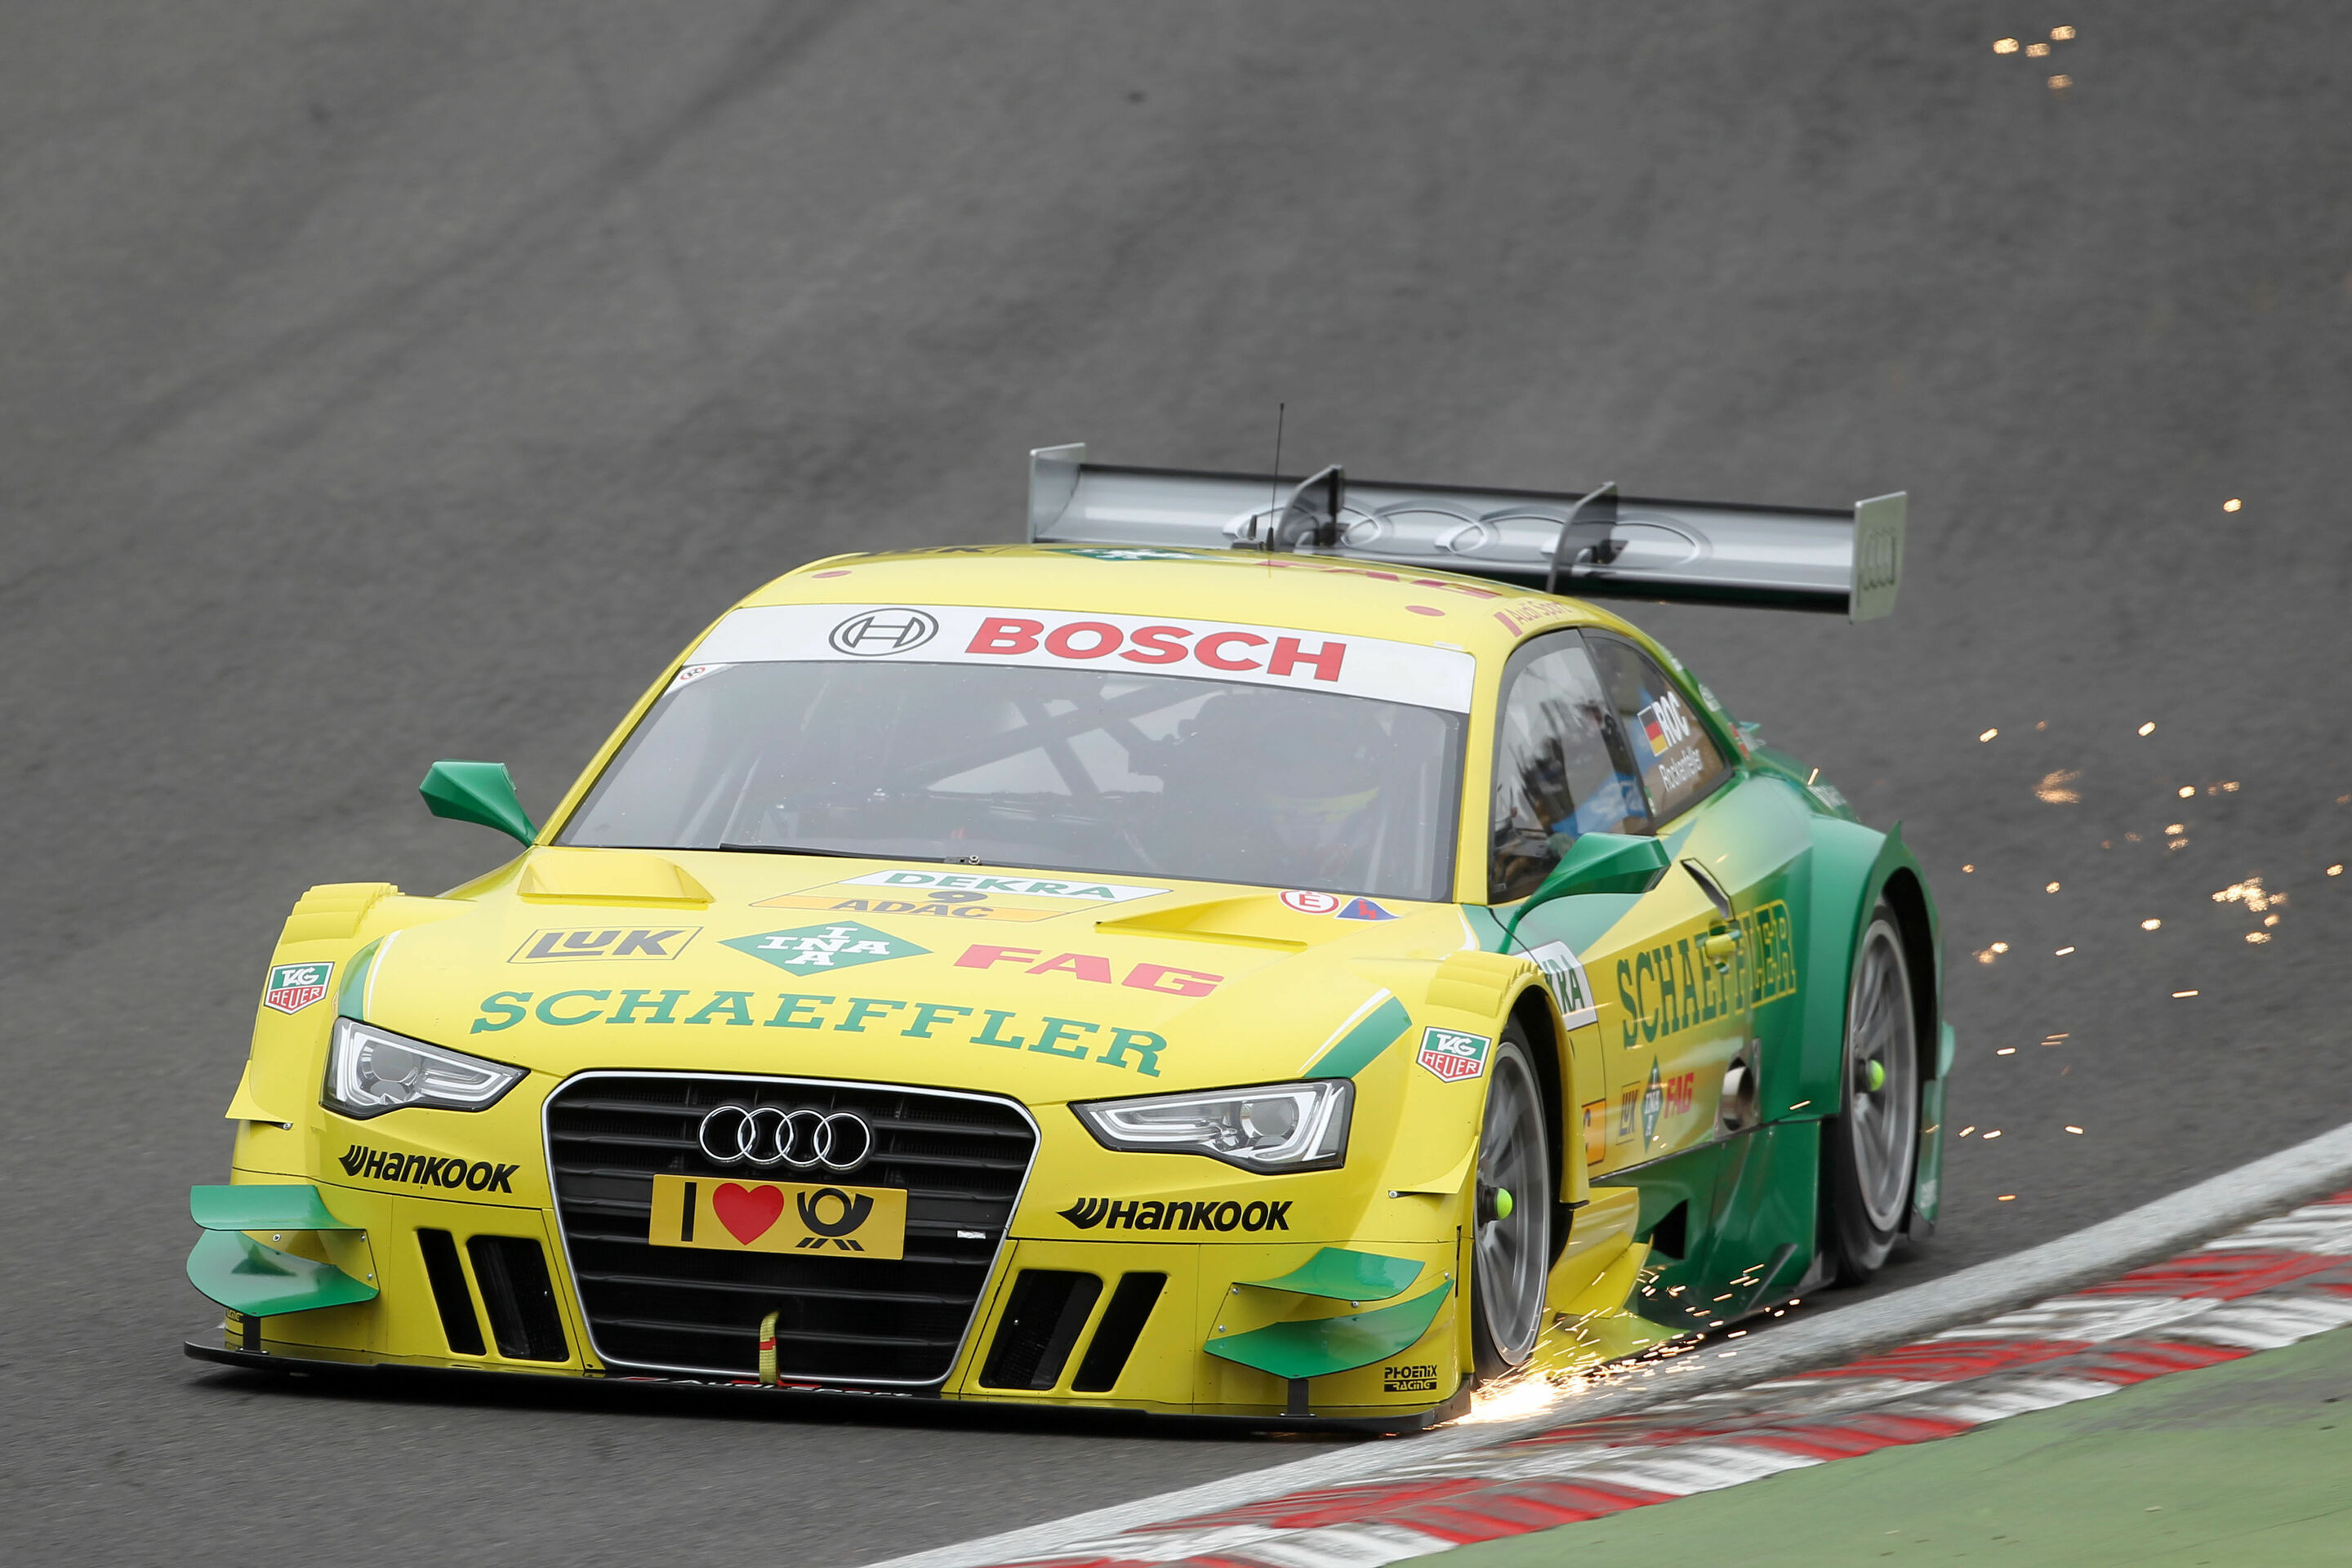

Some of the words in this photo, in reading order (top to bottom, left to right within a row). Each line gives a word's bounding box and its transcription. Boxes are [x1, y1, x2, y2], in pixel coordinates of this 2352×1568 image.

[964, 617, 1347, 683] BOSCH
[1651, 691, 1690, 747] ROC
[884, 872, 1118, 899] DEKRA
[928, 891, 988, 903] 9
[830, 898, 994, 920] ADAC
[756, 936, 891, 955] INA
[282, 967, 319, 987] TAG
[952, 944, 1225, 998] FAG
[271, 987, 320, 1009] HEUER
[470, 989, 1169, 1078] SCHAEFFLER
[1437, 1033, 1476, 1056] TAG
[1424, 1053, 1477, 1077] HEUER
[1664, 1072, 1695, 1119] FAG
